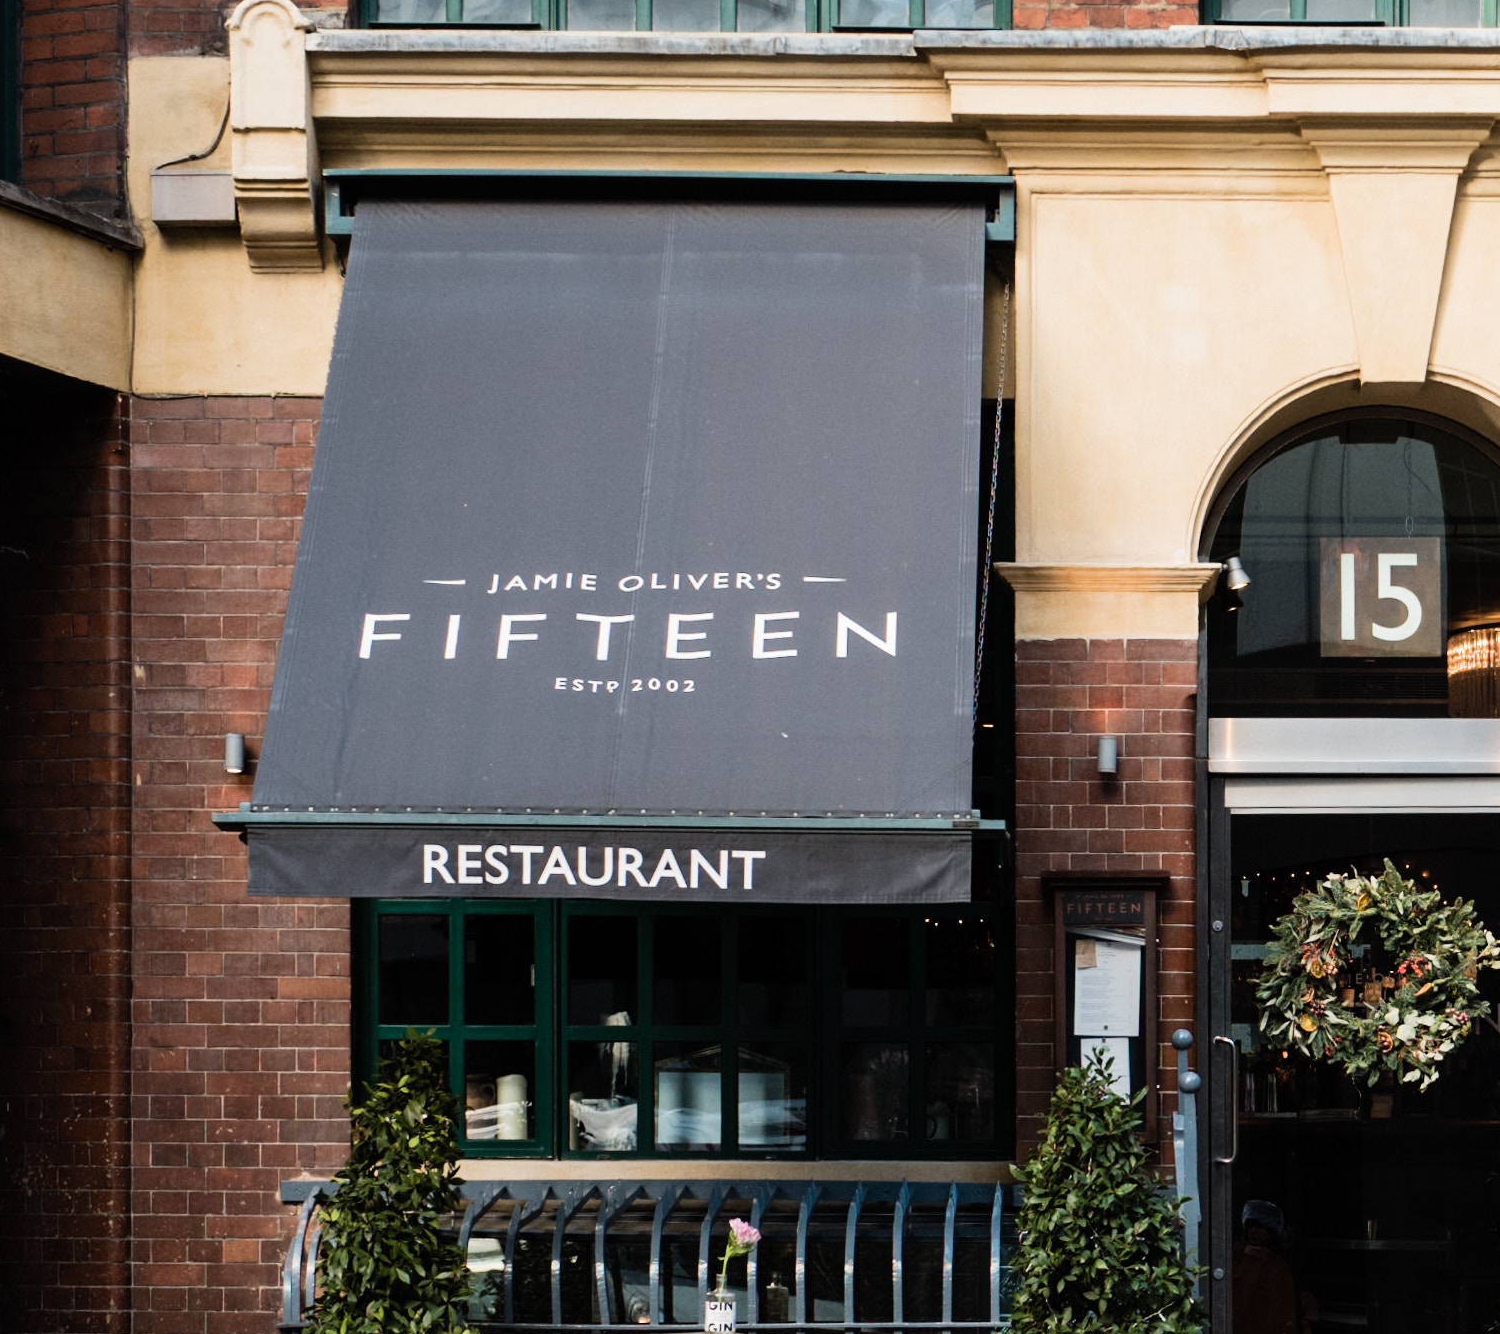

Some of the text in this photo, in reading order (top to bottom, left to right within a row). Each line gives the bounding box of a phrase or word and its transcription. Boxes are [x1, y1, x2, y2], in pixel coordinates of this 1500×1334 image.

[487, 571, 782, 595] JAMIE OLIVER'S
[1340, 553, 1423, 642] 15
[359, 611, 899, 662] FIFTEEN
[631, 677, 696, 693] 2002
[423, 843, 767, 891] RESTAURANT
[1066, 902, 1142, 915] FIFTEEN
[709, 1301, 733, 1311] GIN
[709, 1323, 733, 1332] GIN
